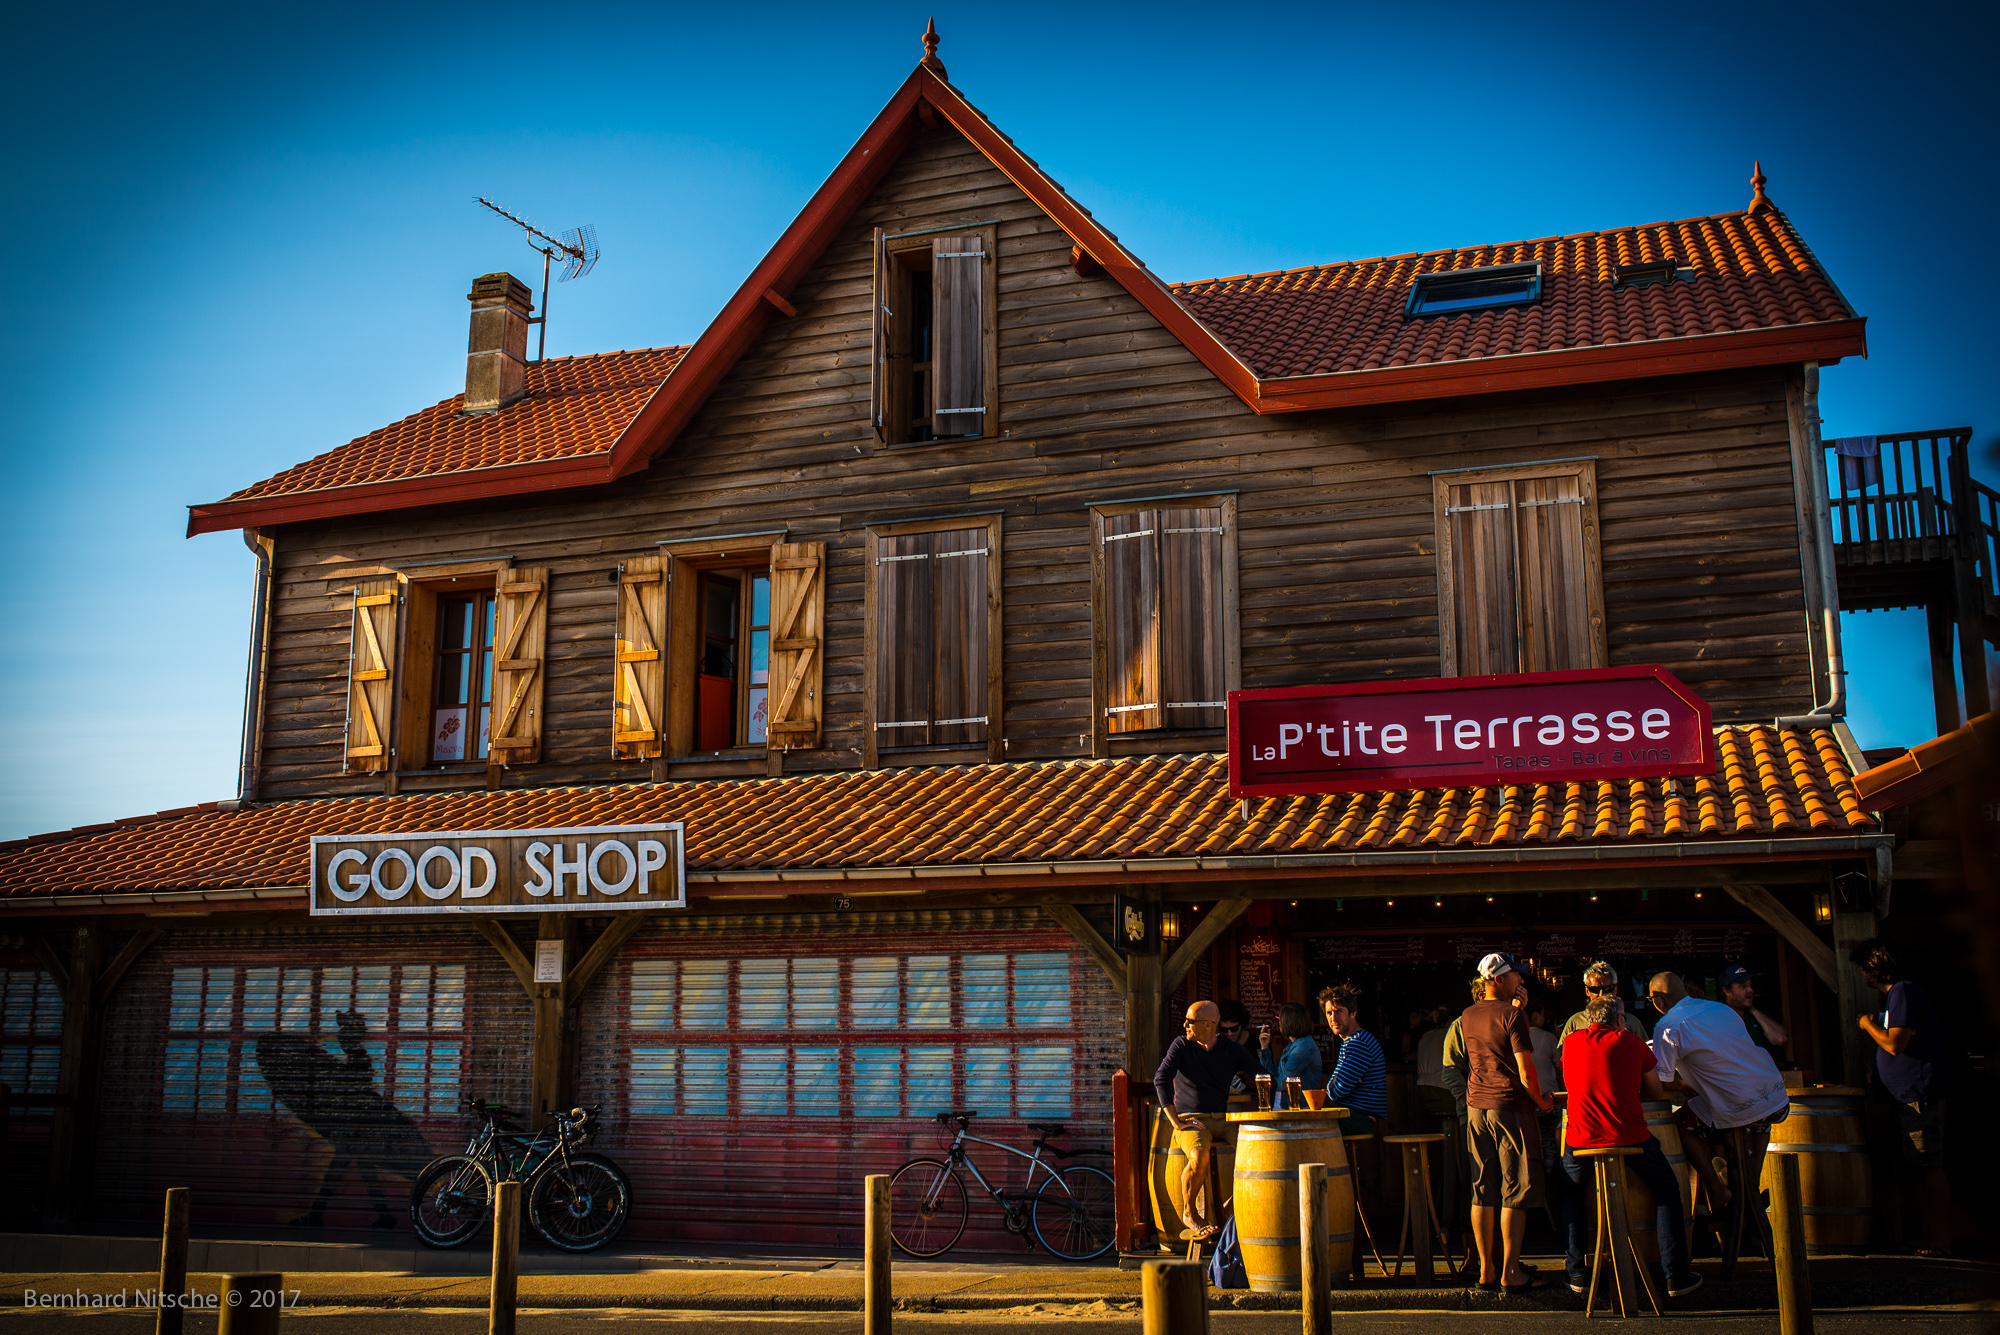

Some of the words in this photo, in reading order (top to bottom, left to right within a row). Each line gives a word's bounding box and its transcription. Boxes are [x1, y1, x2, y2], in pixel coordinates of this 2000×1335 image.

[1252, 745, 1276, 761] La
[1279, 720, 1408, 760] P'tite
[1424, 708, 1671, 751] Terrasse
[435, 744, 463, 754] Maeva
[1492, 754, 1551, 771] Tapas
[1572, 751, 1605, 765] Bar
[1612, 748, 1623, 763] à
[1629, 747, 1672, 762] vins
[327, 845, 497, 902] GOOD
[523, 839, 667, 898] SHOP
[838, 899, 850, 908] 75
[78, 927, 88, 936] 69
